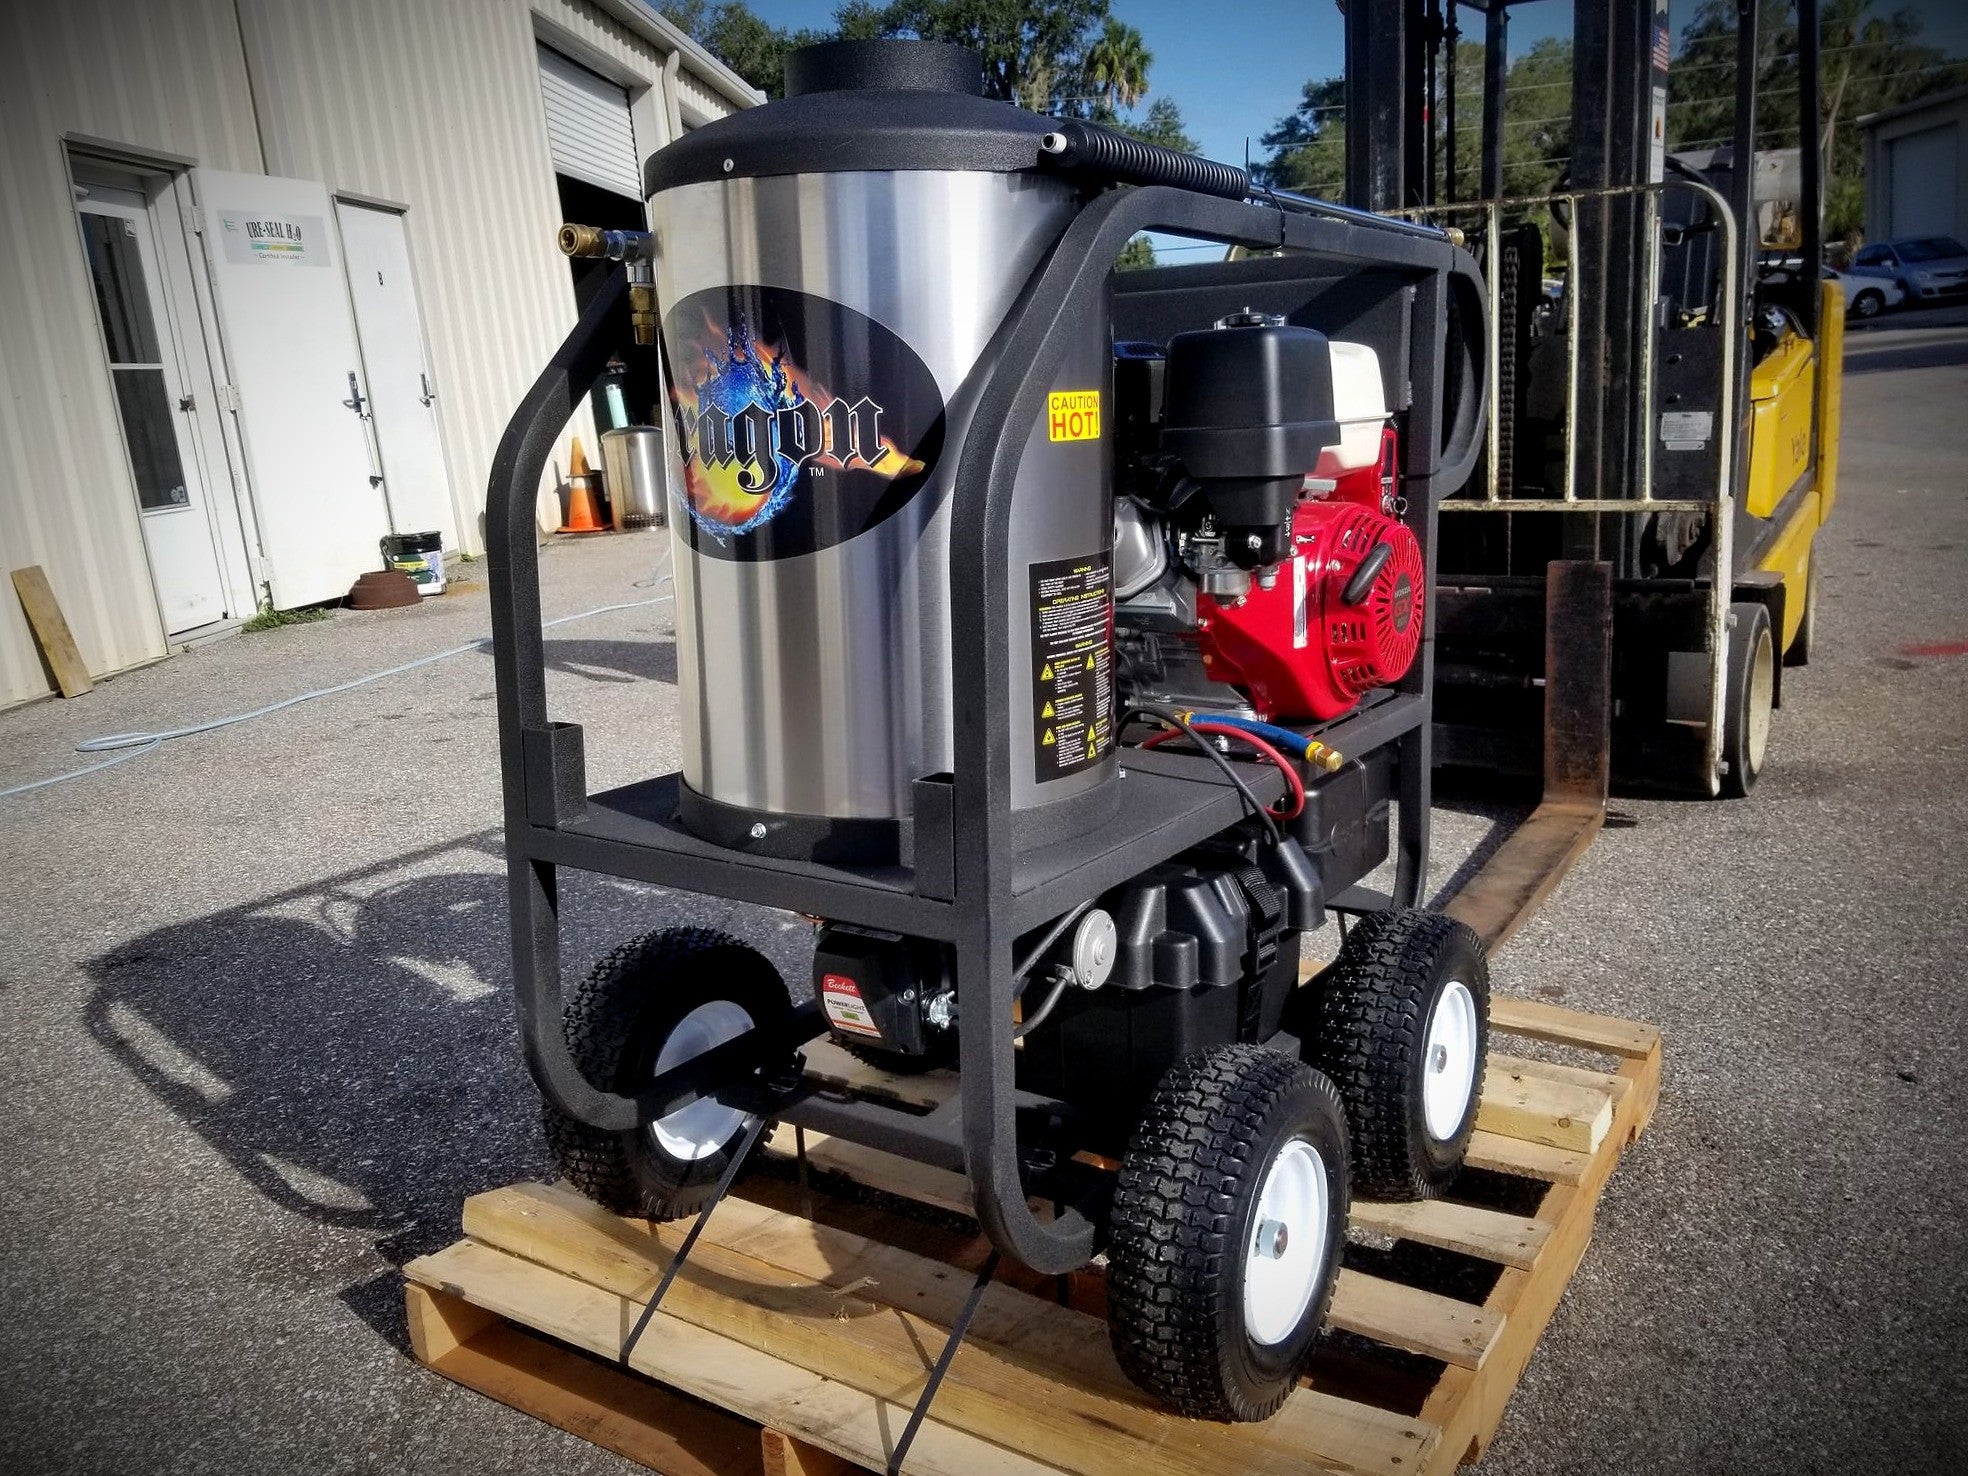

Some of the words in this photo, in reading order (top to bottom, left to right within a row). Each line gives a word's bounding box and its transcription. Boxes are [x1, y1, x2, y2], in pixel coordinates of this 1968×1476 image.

[1052, 395, 1098, 411] CAUTION
[1052, 411, 1098, 438] HOT!
[674, 396, 890, 495] ragon
[809, 467, 824, 477] TM
[1395, 586, 1411, 598] HONDA
[828, 978, 856, 993] Beckett
